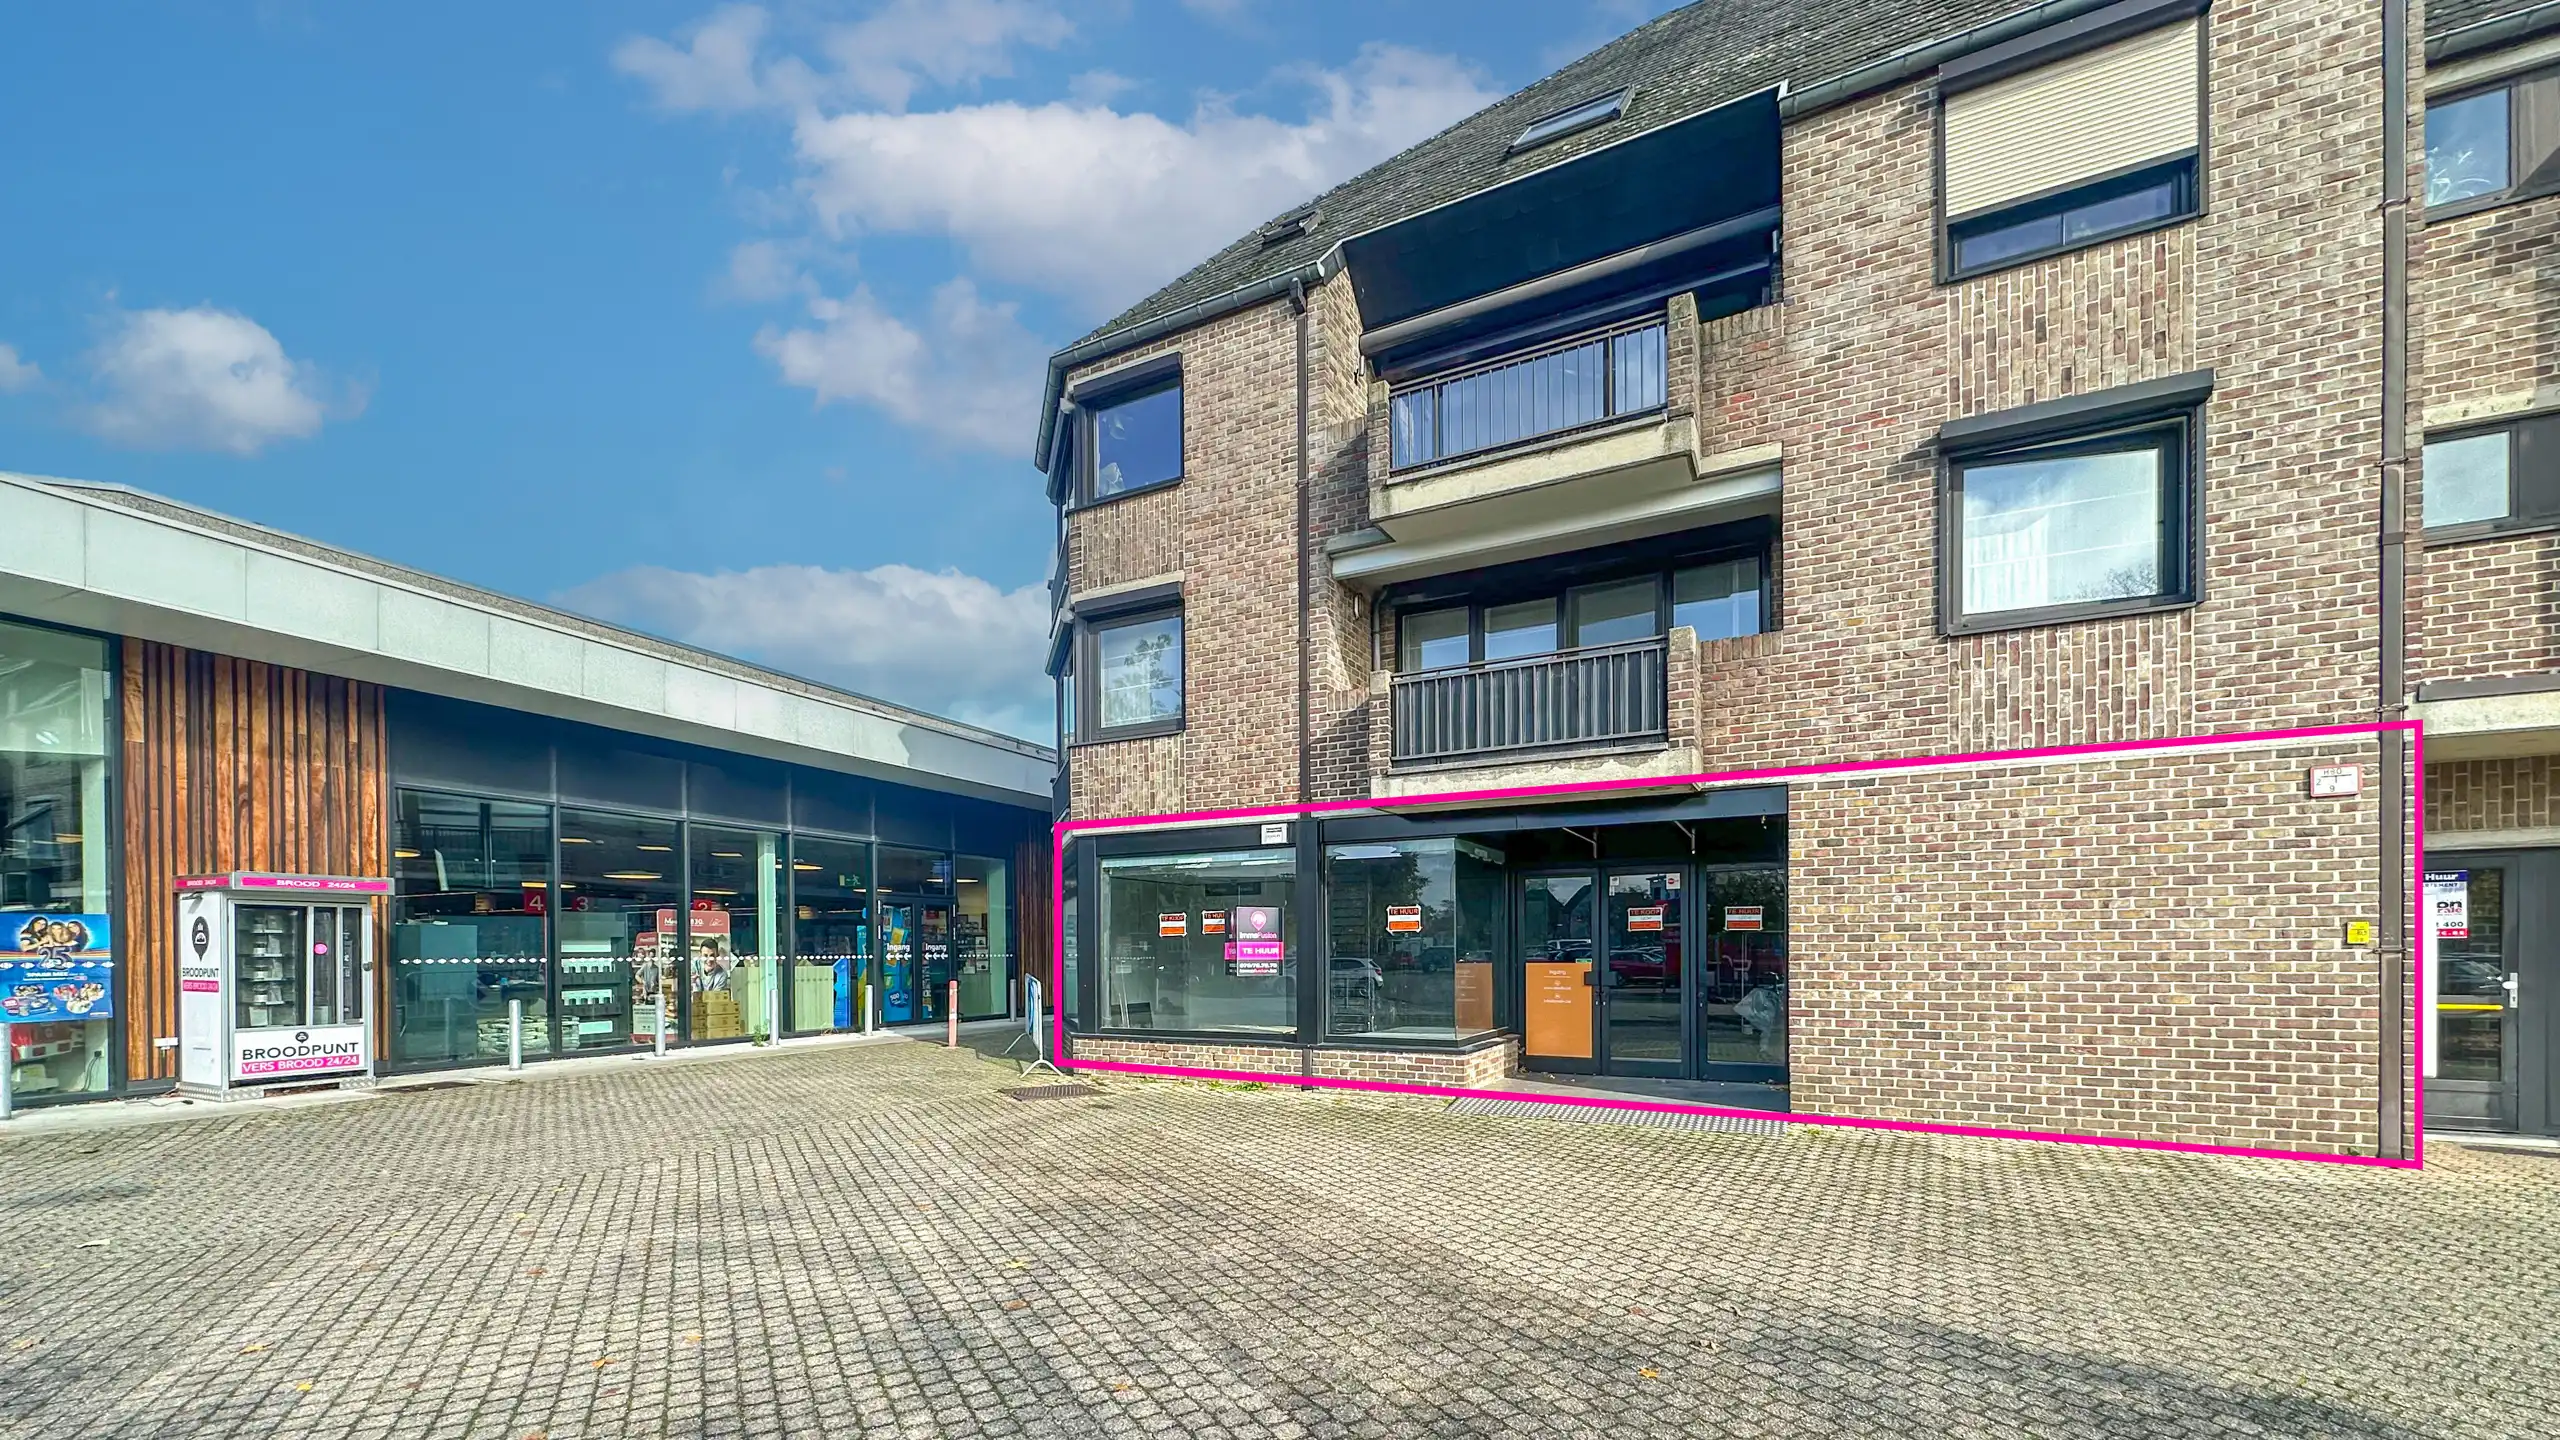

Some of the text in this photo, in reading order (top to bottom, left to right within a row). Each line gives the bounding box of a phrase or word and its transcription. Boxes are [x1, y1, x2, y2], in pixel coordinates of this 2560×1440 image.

[2425, 873, 2459, 881] Huur
[529, 895, 544, 911] 4
[576, 896, 589, 912] 3
[887, 944, 910, 952] Ingang
[925, 943, 947, 952] Ingang
[182, 967, 219, 977] BROODPUNT
[242, 1042, 359, 1060] BROODPUNT
[243, 1056, 357, 1072] VERS BROOD 24/24
